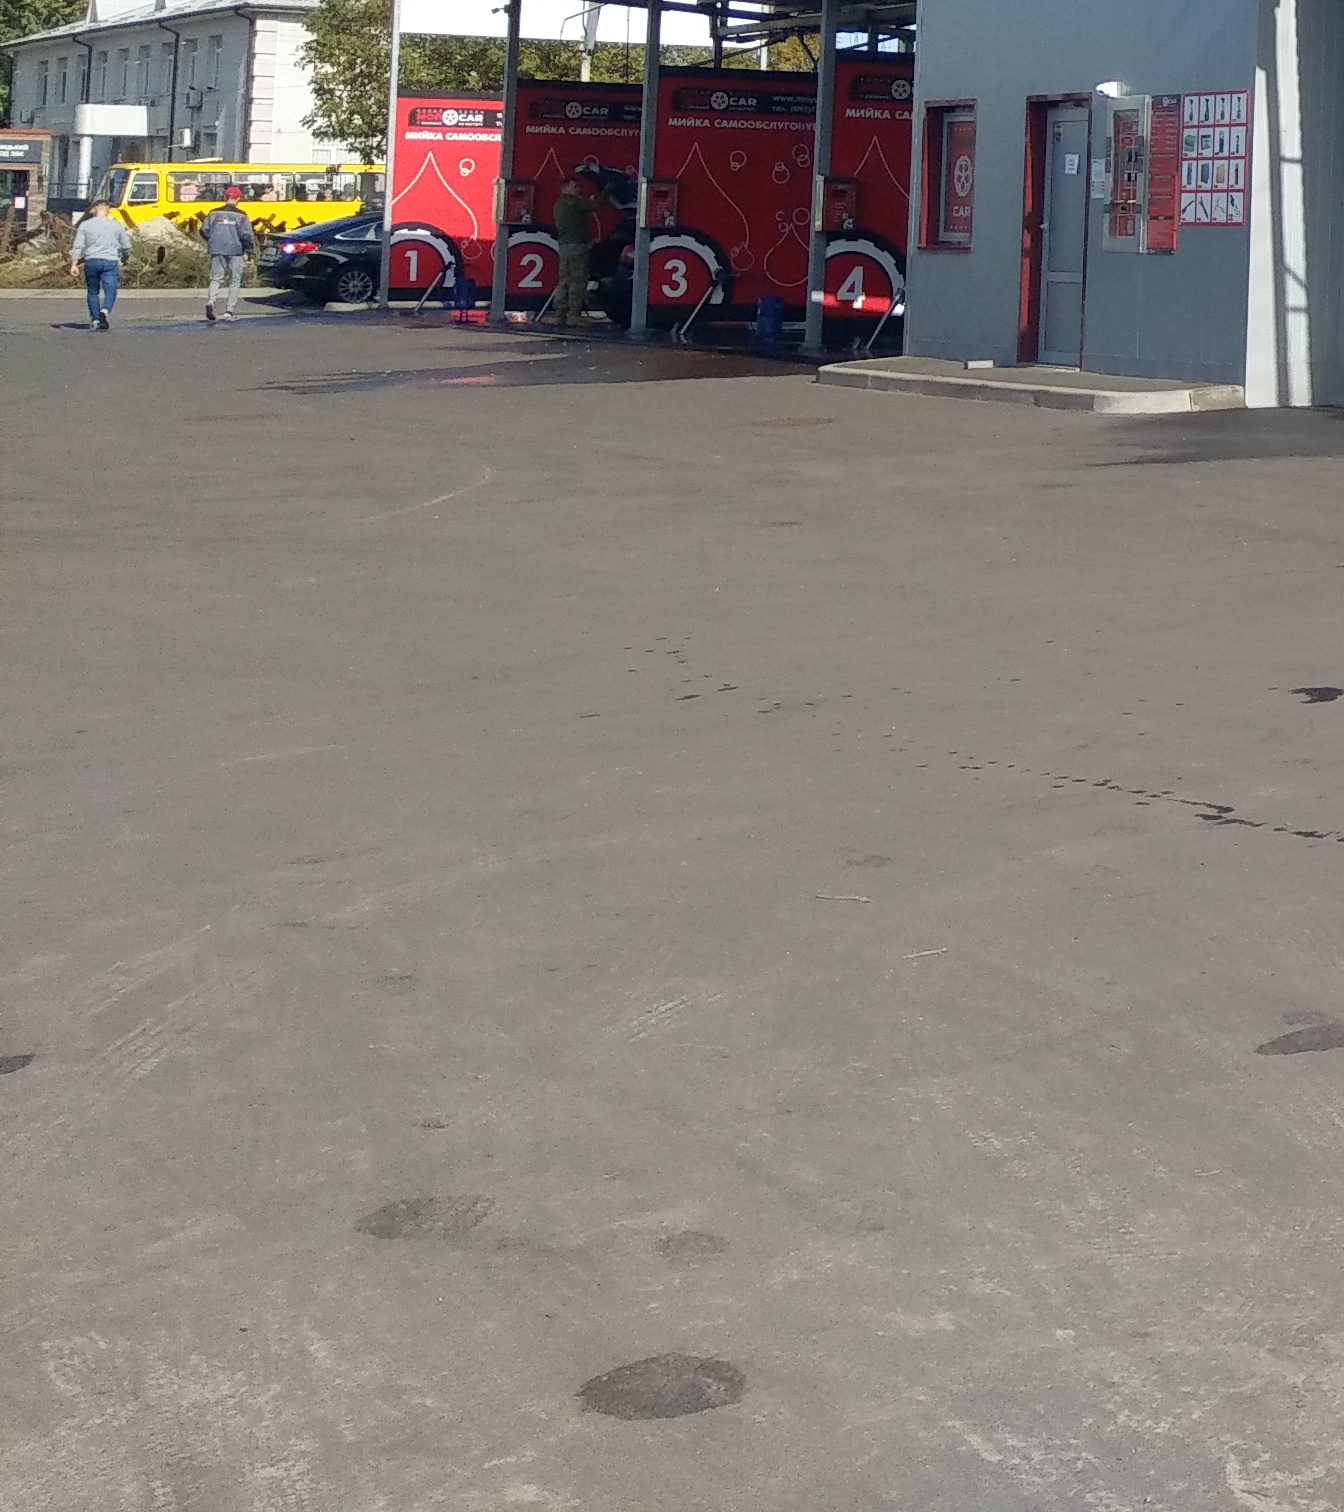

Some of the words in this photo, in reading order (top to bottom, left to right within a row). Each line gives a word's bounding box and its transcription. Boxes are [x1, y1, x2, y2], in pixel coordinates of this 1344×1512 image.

[730, 96, 758, 107] CAR
[583, 106, 608, 116] CAR
[845, 107, 891, 120] МИЙКА
[459, 114, 484, 123] CAR
[668, 116, 711, 128] МИЙКА
[405, 130, 443, 140] МИЙКА
[526, 124, 566, 135] МИЙКА
[952, 205, 971, 217] CAR
[404, 250, 418, 281] 1
[519, 254, 543, 288] 2
[662, 259, 688, 298] 3
[836, 266, 865, 303] 4
